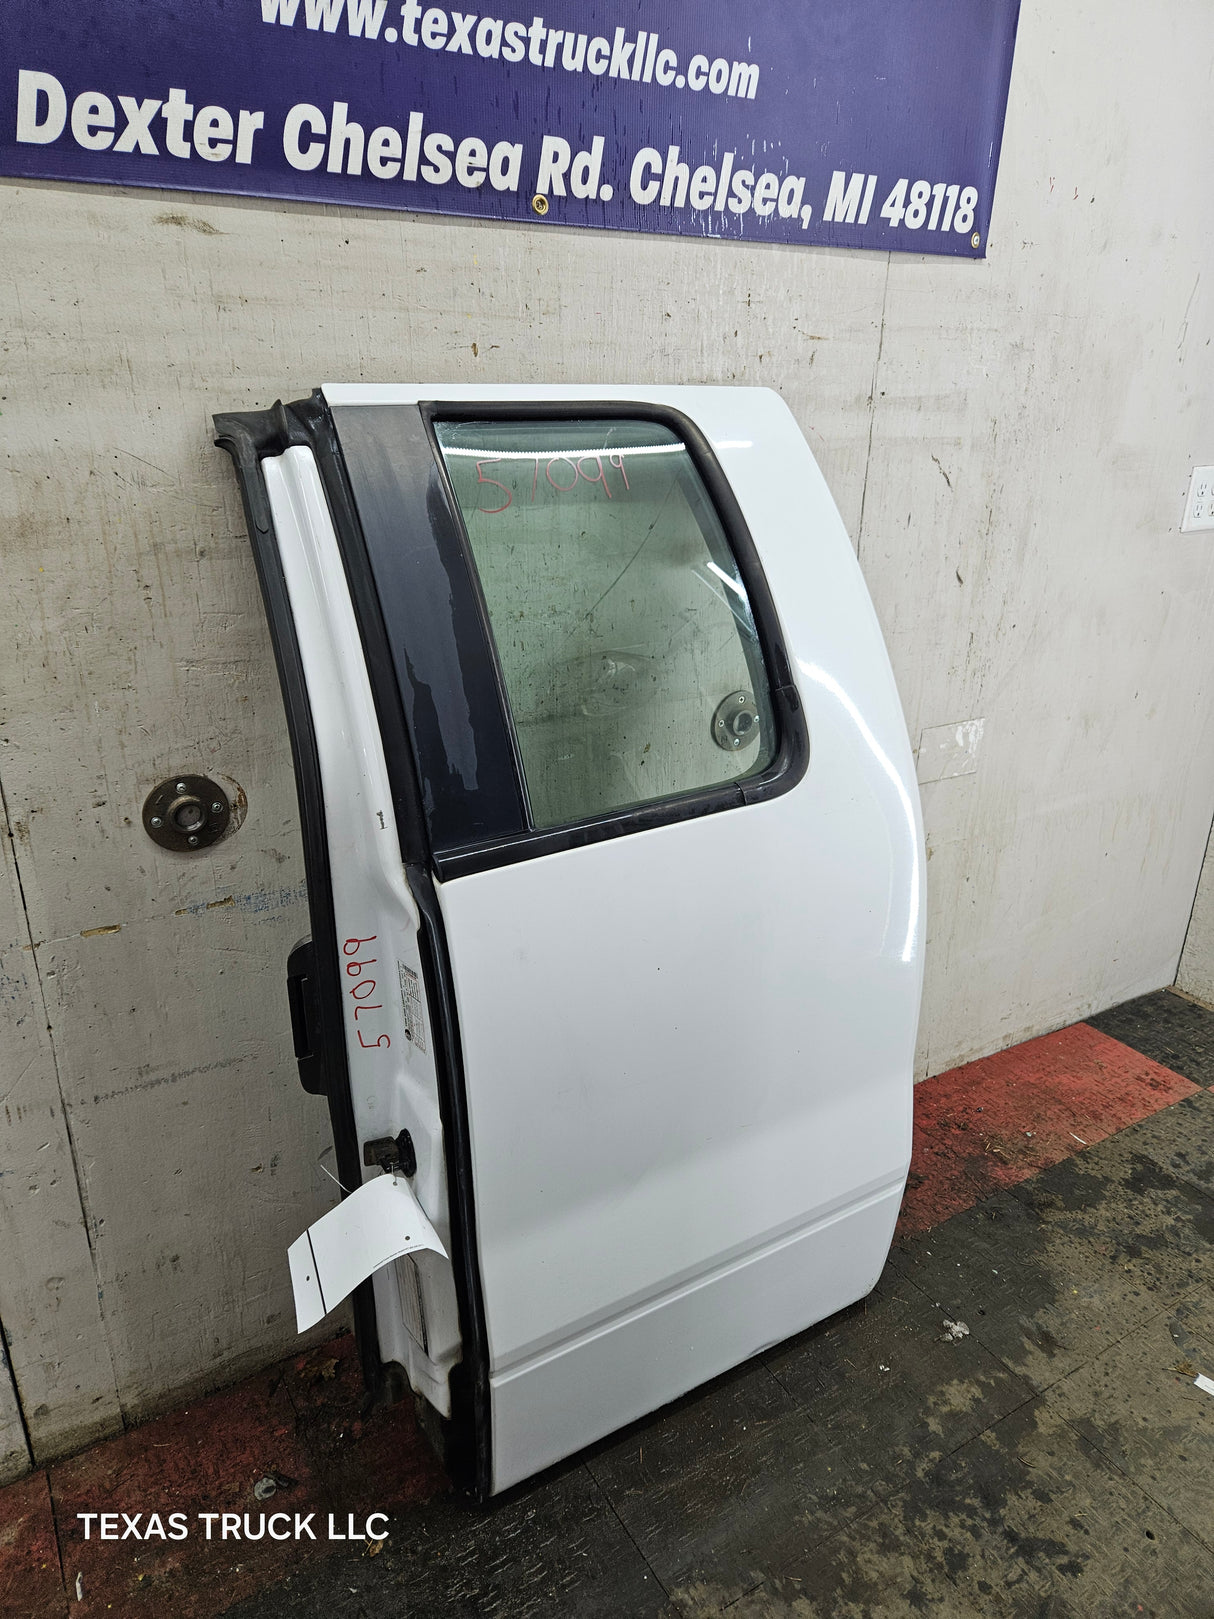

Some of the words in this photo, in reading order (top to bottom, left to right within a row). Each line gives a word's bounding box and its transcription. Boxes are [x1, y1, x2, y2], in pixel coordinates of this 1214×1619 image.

[260, 0, 760, 99] www.texastruckllc.com
[16, 69, 265, 166] Dexter
[282, 101, 523, 192] Chelsea
[536, 135, 614, 202] Rd.
[629, 145, 813, 230] Chelsea,
[822, 170, 880, 225] MI
[880, 178, 979, 234] 48118
[342, 935, 391, 1049] 57099
